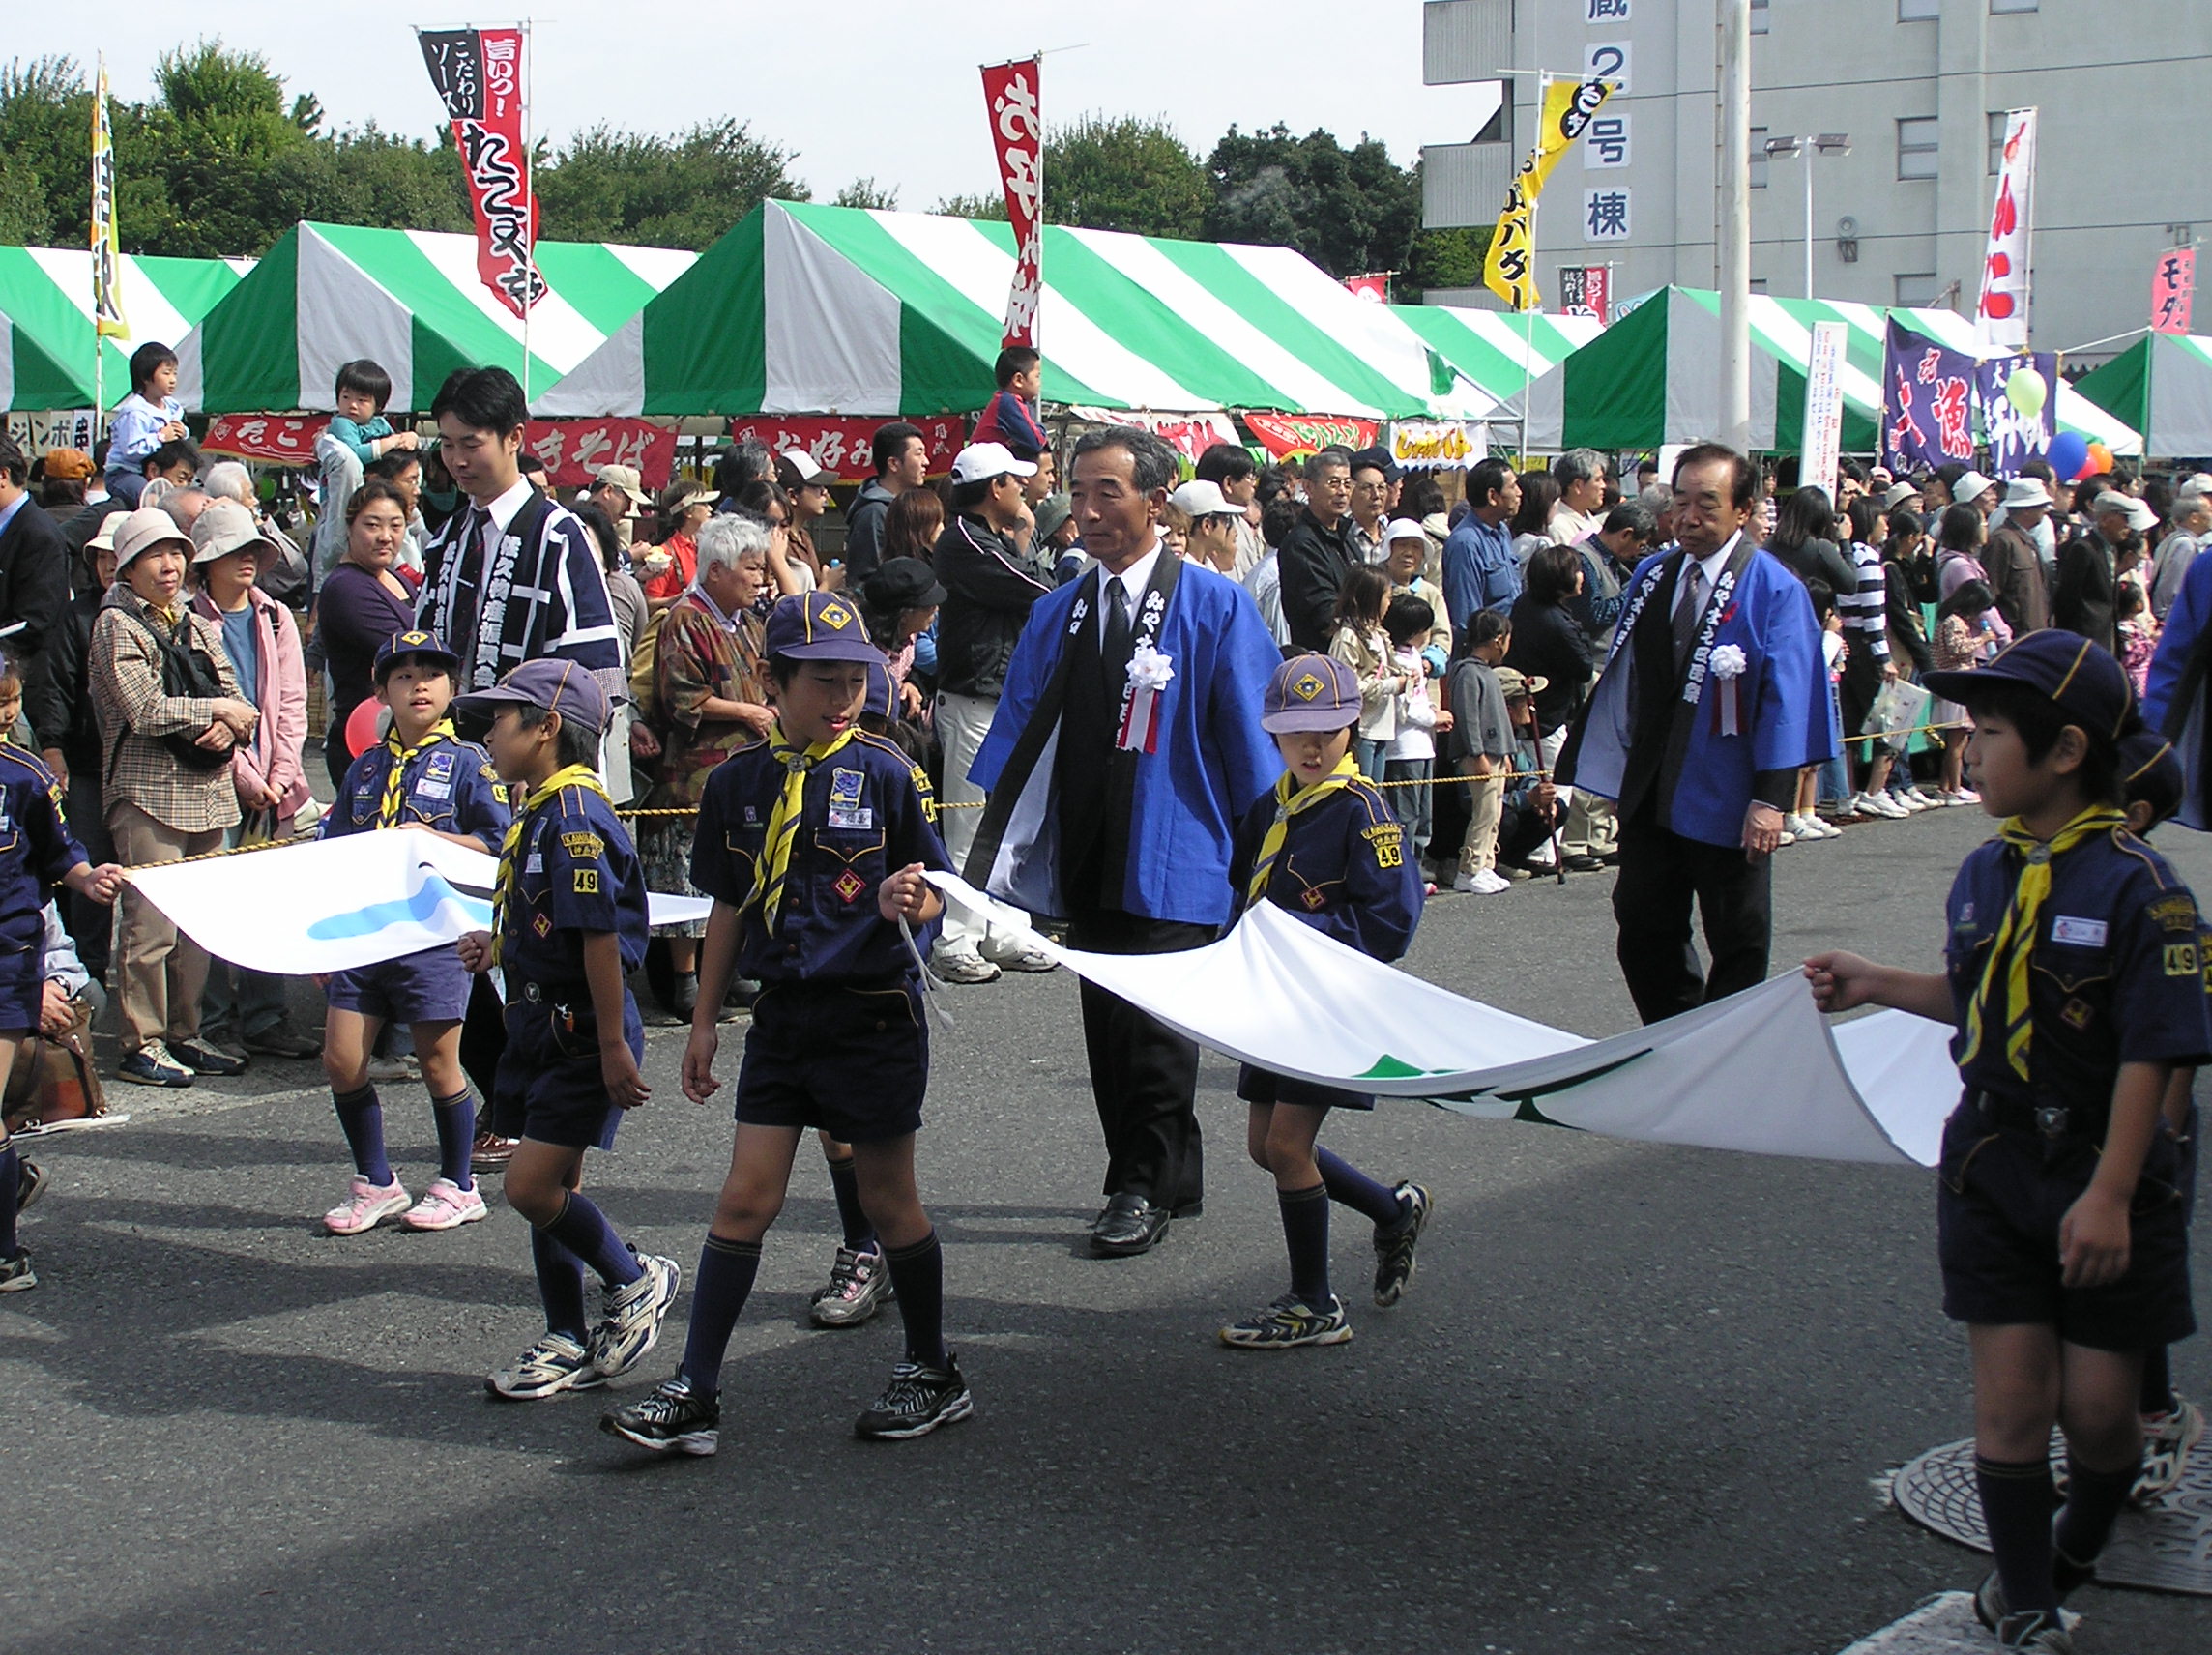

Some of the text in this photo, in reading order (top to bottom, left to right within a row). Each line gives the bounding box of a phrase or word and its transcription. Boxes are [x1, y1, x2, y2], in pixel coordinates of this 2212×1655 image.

[431, 43, 459, 113] ソース
[455, 40, 476, 114] こだわり
[236, 420, 303, 447] たこ
[531, 427, 655, 475] きそば
[1381, 847, 1400, 864] 49
[575, 872, 597, 890] 49
[2168, 948, 2194, 970] 49
